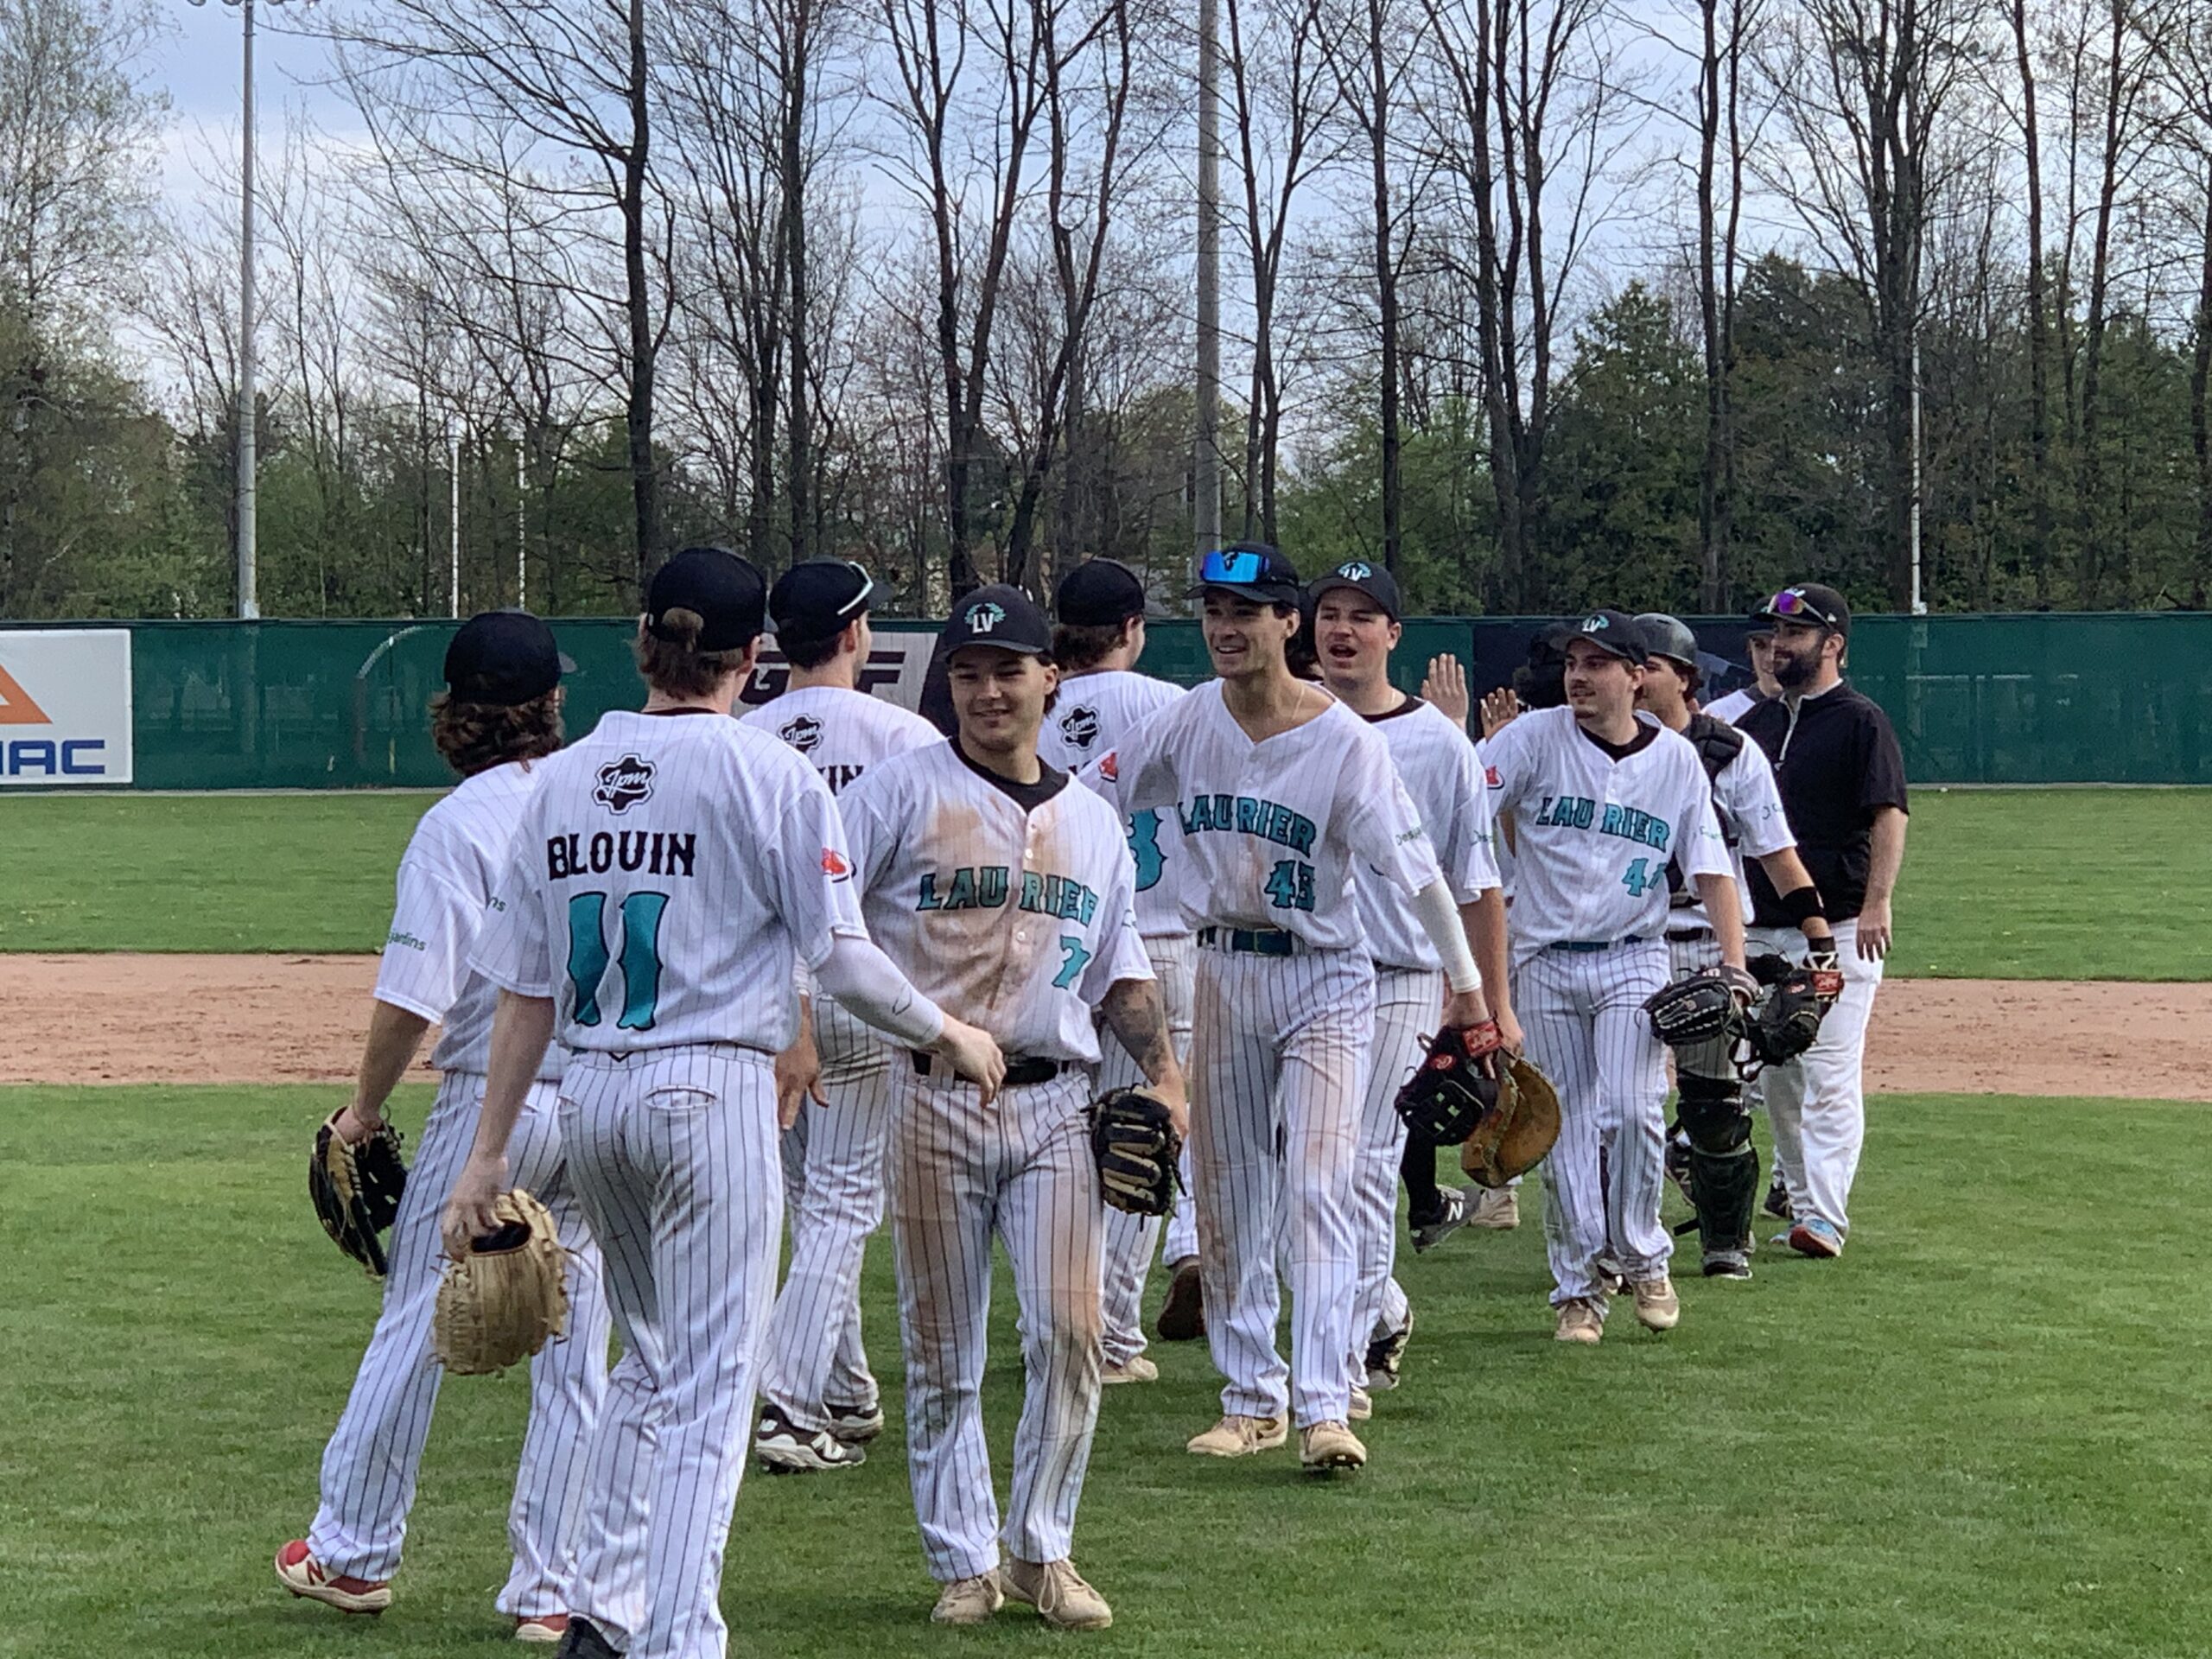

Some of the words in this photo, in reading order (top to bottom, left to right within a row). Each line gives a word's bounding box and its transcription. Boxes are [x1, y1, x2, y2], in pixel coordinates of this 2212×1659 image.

[972, 612, 995, 634] LV
[1178, 794, 1316, 858] LAURIER
[1536, 797, 1670, 853] LAURIER
[548, 830, 696, 880] BLOUIN
[916, 867, 1099, 928] LAURIER
[567, 891, 671, 1031] 11
[1052, 934, 1090, 989] 7
